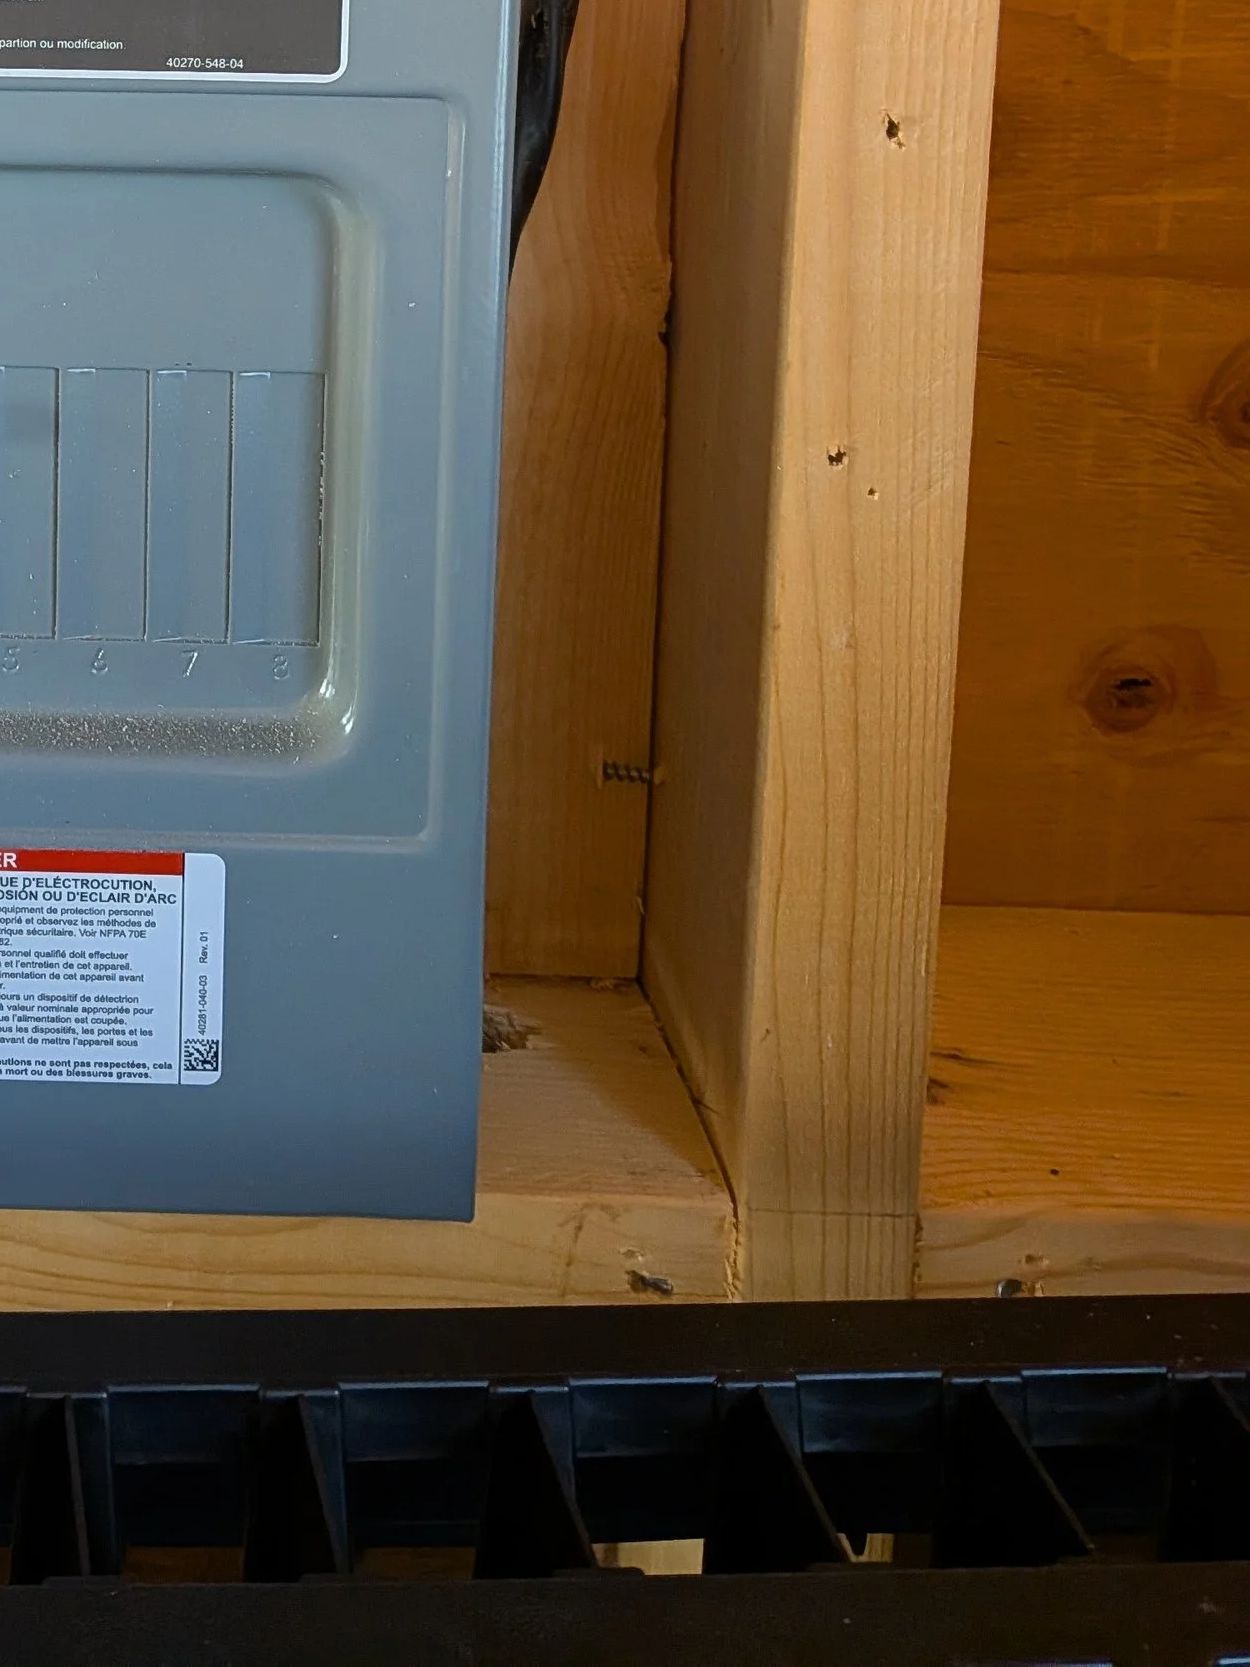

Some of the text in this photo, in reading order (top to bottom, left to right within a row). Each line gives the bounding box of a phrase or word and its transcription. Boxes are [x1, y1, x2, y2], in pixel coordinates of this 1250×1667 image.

[39, 40, 53, 48] ou
[166, 57, 244, 68] 40270-548-04
[92, 647, 108, 675] 6
[182, 650, 198, 677] 7
[273, 654, 289, 680] 8
[42, 891, 62, 901] OU
[66, 891, 130, 903] D'ECLAIR
[134, 892, 176, 904] D'ARC
[197, 931, 209, 1036] 40281-040-03 Rev. 01
